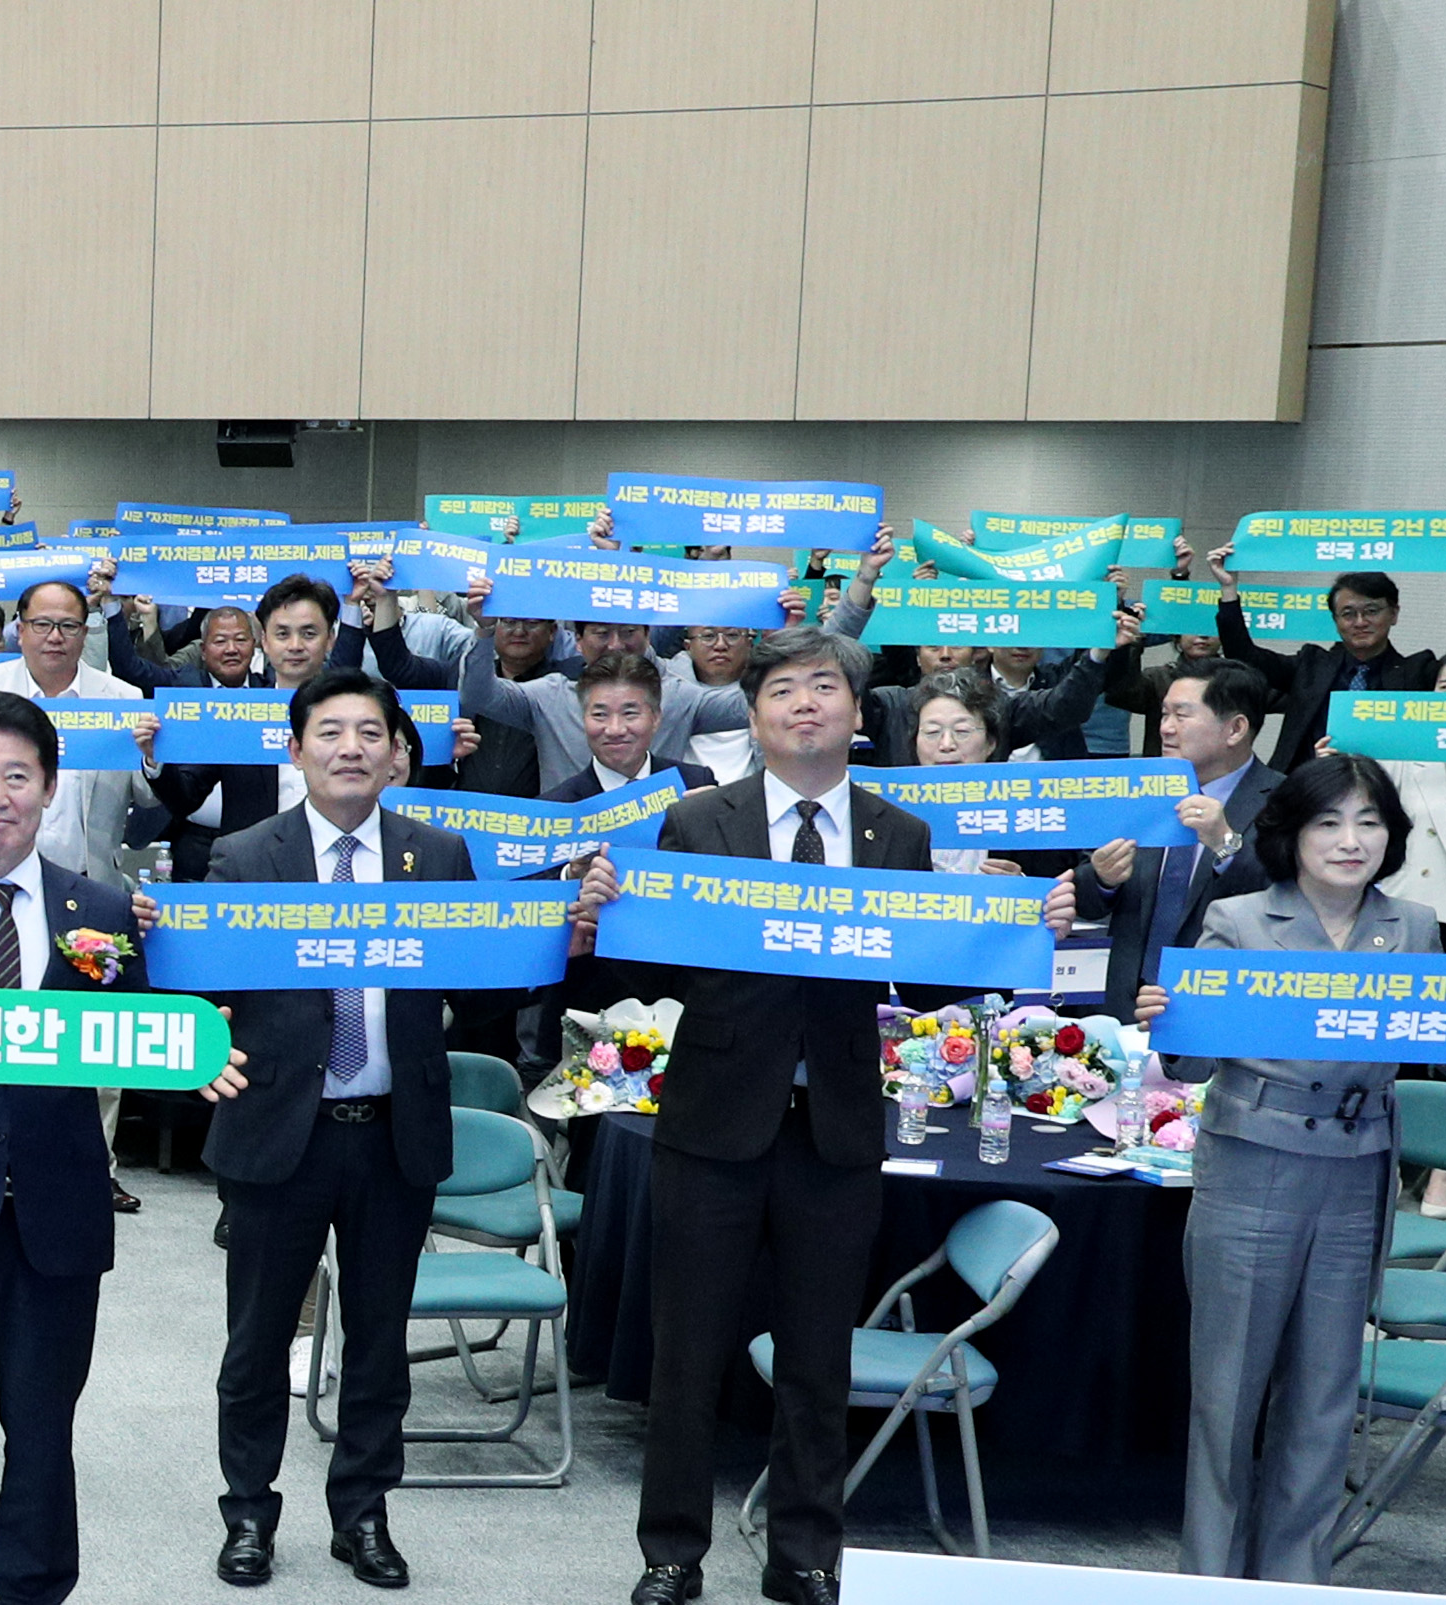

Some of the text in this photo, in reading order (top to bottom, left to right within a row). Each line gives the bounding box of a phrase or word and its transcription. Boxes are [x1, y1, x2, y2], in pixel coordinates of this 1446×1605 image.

[703, 513, 785, 533] 전국 최초
[1247, 519, 1424, 536] 주민 체감안전도 2년
[1316, 542, 1394, 560] 전국 1위
[196, 566, 267, 583] 전국 최초
[591, 587, 679, 613] 전국 최초
[907, 588, 1097, 609] 체감안전도 2년 연속
[938, 614, 1019, 633] 전국 1위
[957, 807, 1066, 834] 전국 최초
[496, 842, 546, 866] 전국
[762, 920, 892, 958] 전국 최초
[296, 938, 423, 967] 전국 최초
[1173, 970, 1228, 996] 시군
[1315, 1009, 1378, 1040] 전국
[79, 1010, 196, 1072] 미래
